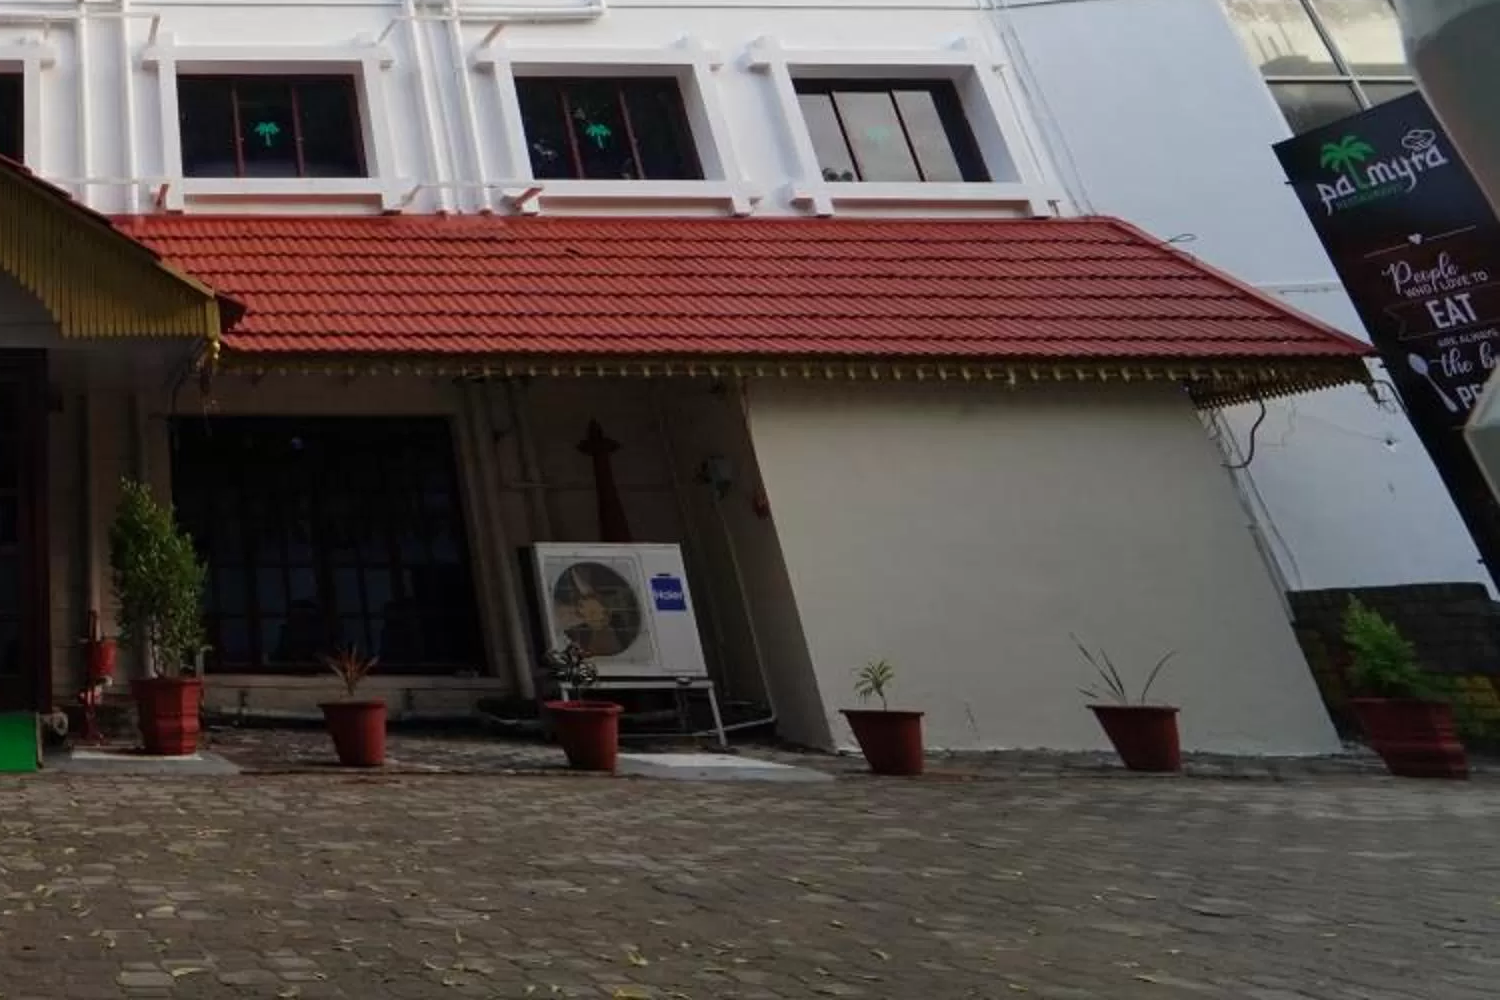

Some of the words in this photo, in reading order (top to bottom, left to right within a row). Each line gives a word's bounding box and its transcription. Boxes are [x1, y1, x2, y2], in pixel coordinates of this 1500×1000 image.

[1316, 136, 1449, 216] palmyra
[1381, 251, 1458, 295] People
[1425, 293, 1477, 329] EAT
[1431, 347, 1474, 378] the
